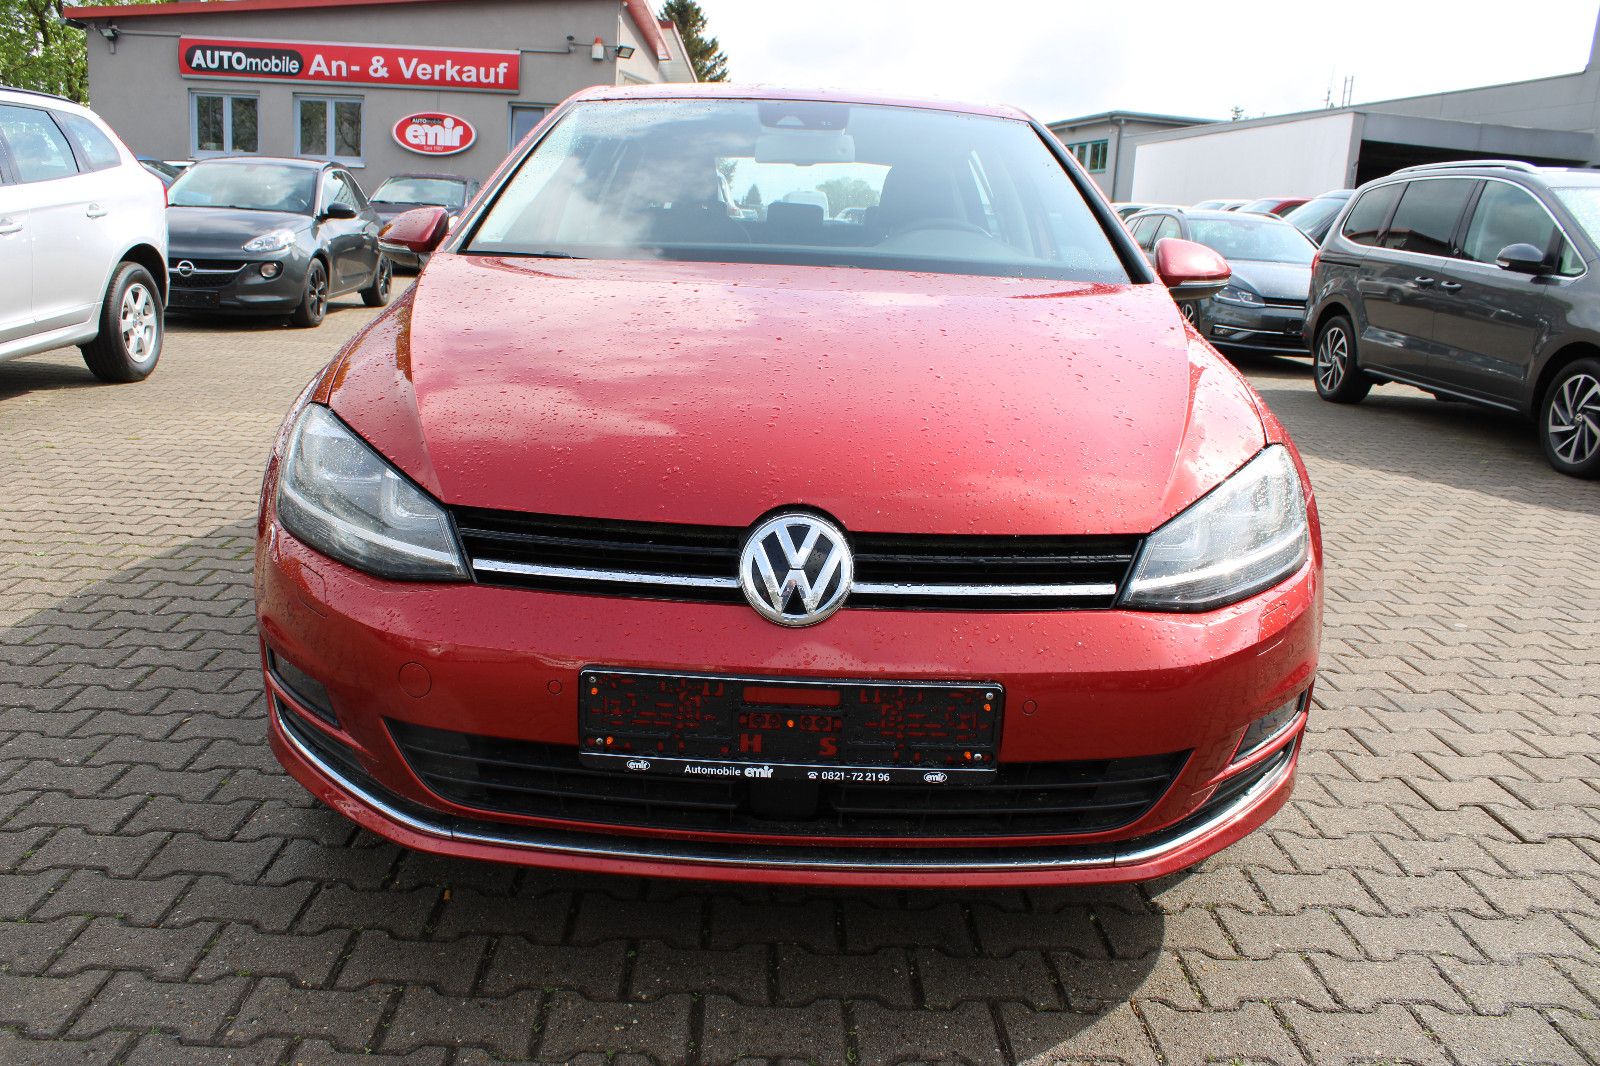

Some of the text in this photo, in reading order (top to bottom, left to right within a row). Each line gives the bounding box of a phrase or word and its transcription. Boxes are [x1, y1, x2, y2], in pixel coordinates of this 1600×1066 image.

[191, 49, 299, 73] AUTOmobile
[308, 53, 509, 84] An- & Verkauf
[405, 117, 464, 147] emir
[743, 514, 852, 626] VW
[628, 759, 649, 770] emir
[684, 764, 774, 779] Automobile emir
[925, 772, 946, 783] emir
